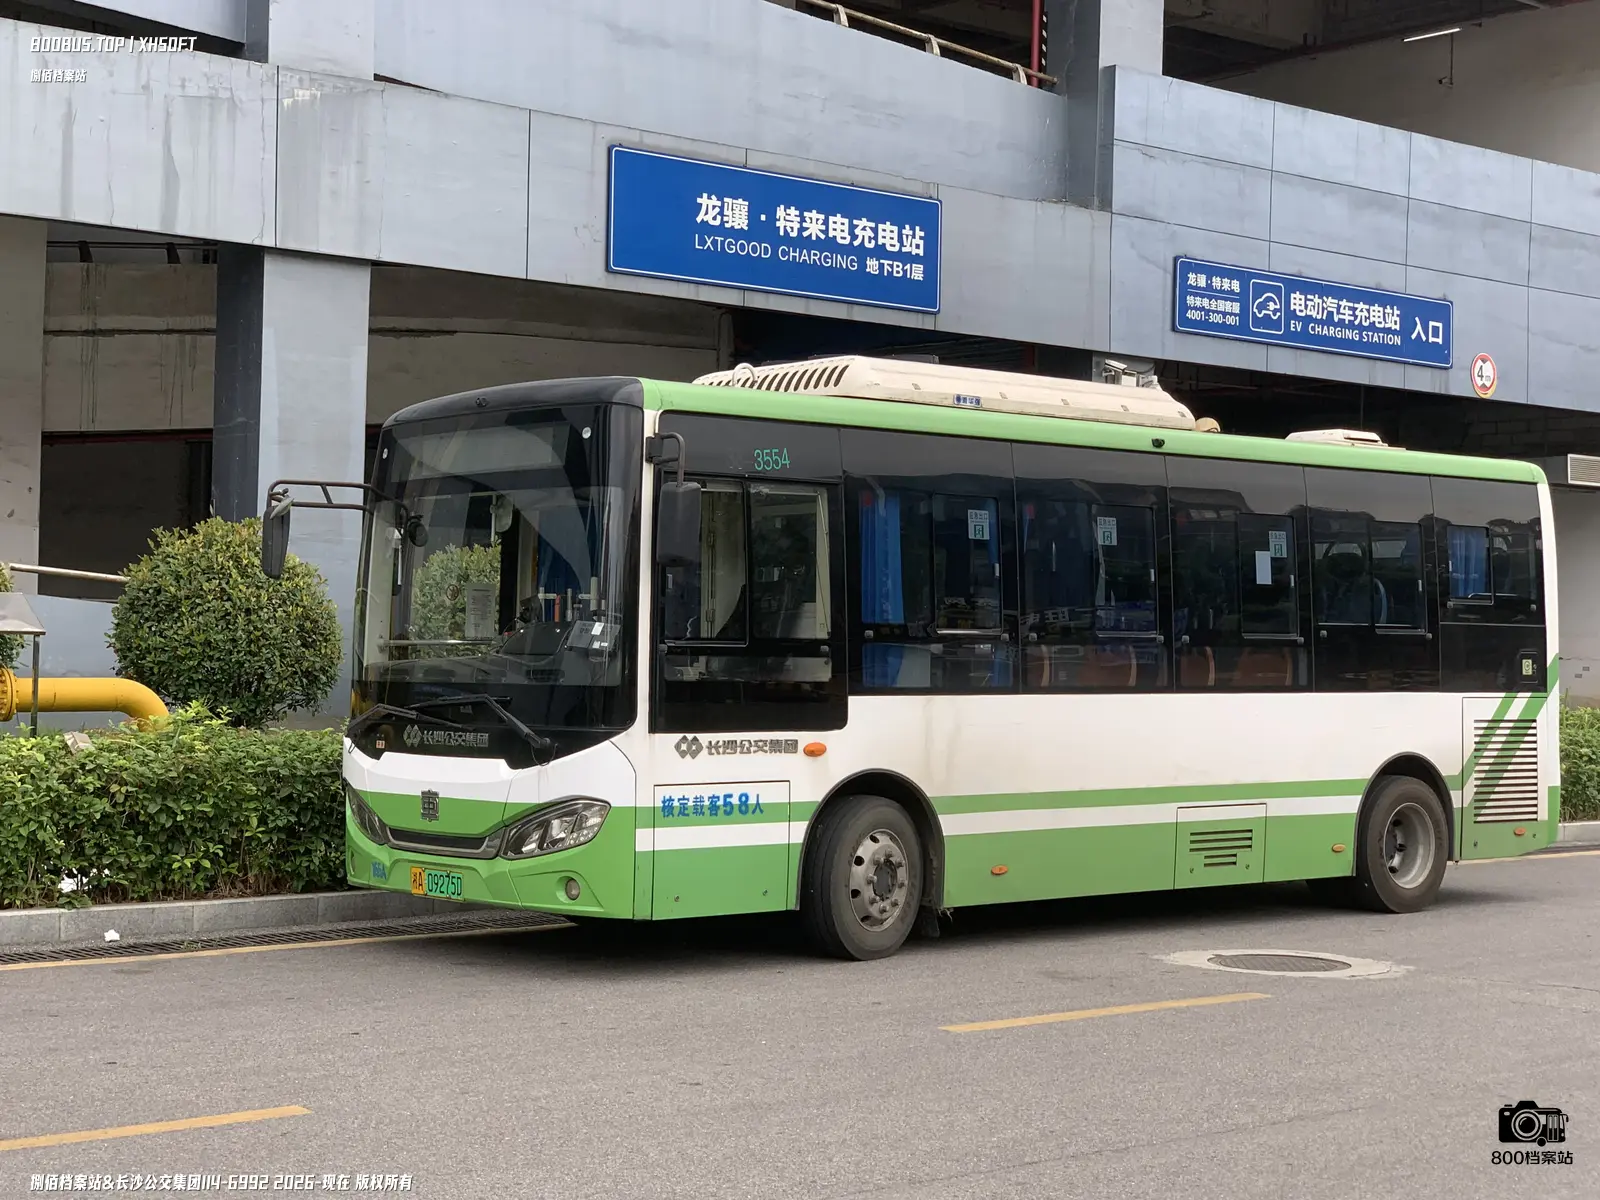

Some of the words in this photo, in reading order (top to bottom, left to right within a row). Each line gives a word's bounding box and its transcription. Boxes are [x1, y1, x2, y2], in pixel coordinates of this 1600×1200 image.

[695, 233, 771, 259] LXTGOOD
[778, 245, 858, 271] CHARGING
[865, 257, 924, 281] 地下B1层
[1186, 295, 1240, 314] 特来电全国客服
[1186, 309, 1239, 326] 4001-300-001
[1290, 291, 1400, 331] 电动汽车充电站
[1410, 316, 1443, 345] 入口
[1290, 320, 1303, 332] EV
[1308, 323, 1359, 341] CHARGING
[1362, 331, 1401, 346] STATION
[1477, 365, 1484, 381] 4
[754, 448, 791, 471] 3554
[422, 730, 489, 748] 长沙公交集团
[706, 739, 799, 756] 长沙公交集团
[660, 792, 764, 818] 核定载客58人
